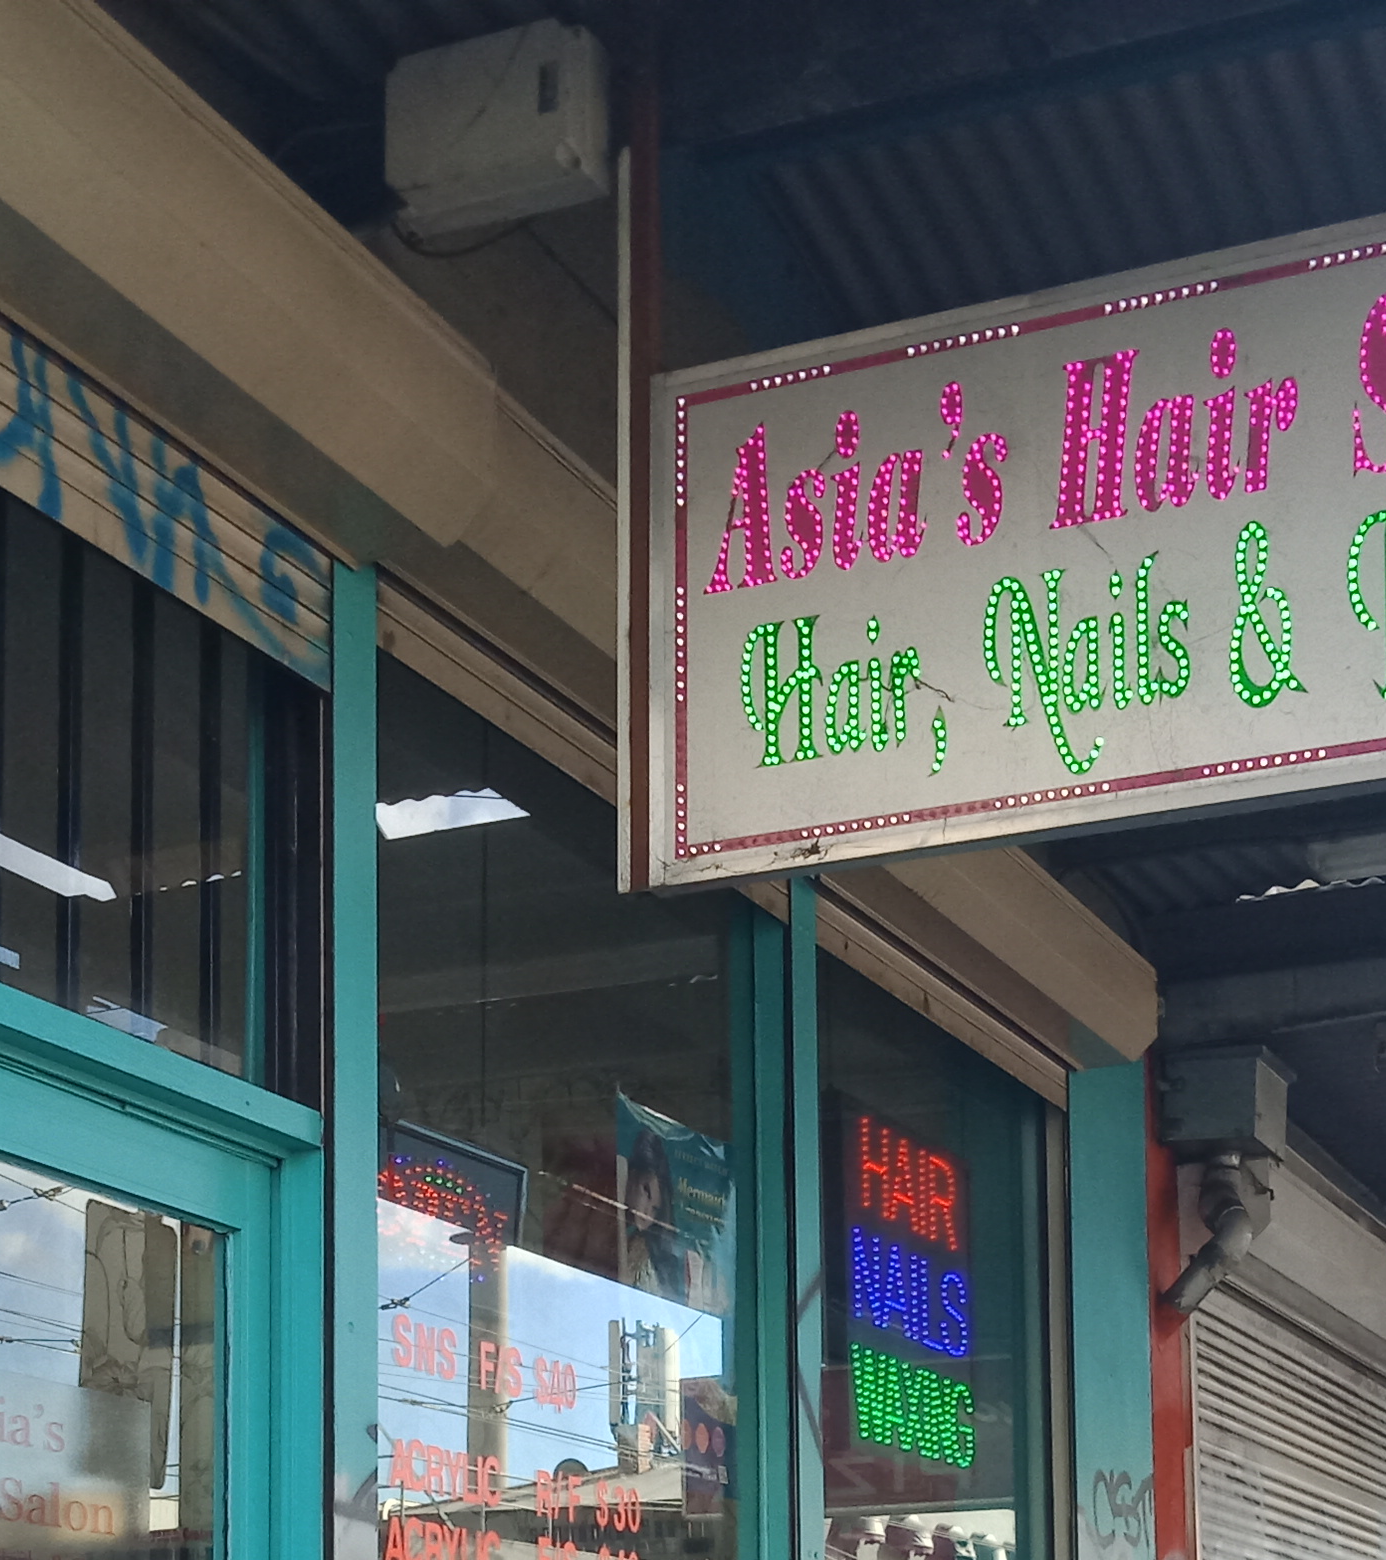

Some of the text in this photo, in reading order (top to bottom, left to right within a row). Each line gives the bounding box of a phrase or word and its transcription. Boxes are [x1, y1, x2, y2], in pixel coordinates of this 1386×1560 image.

[701, 380, 1009, 595] Asia's
[1049, 328, 1300, 532] Hair
[739, 613, 948, 777] Hair,
[984, 552, 1191, 776] Nails
[1227, 520, 1310, 708] &
[860, 1115, 958, 1250] HAIR
[391, 1314, 457, 1380] SNS
[852, 1227, 967, 1357] NAILS
[390, 1438, 501, 1507] ACRYLIC
